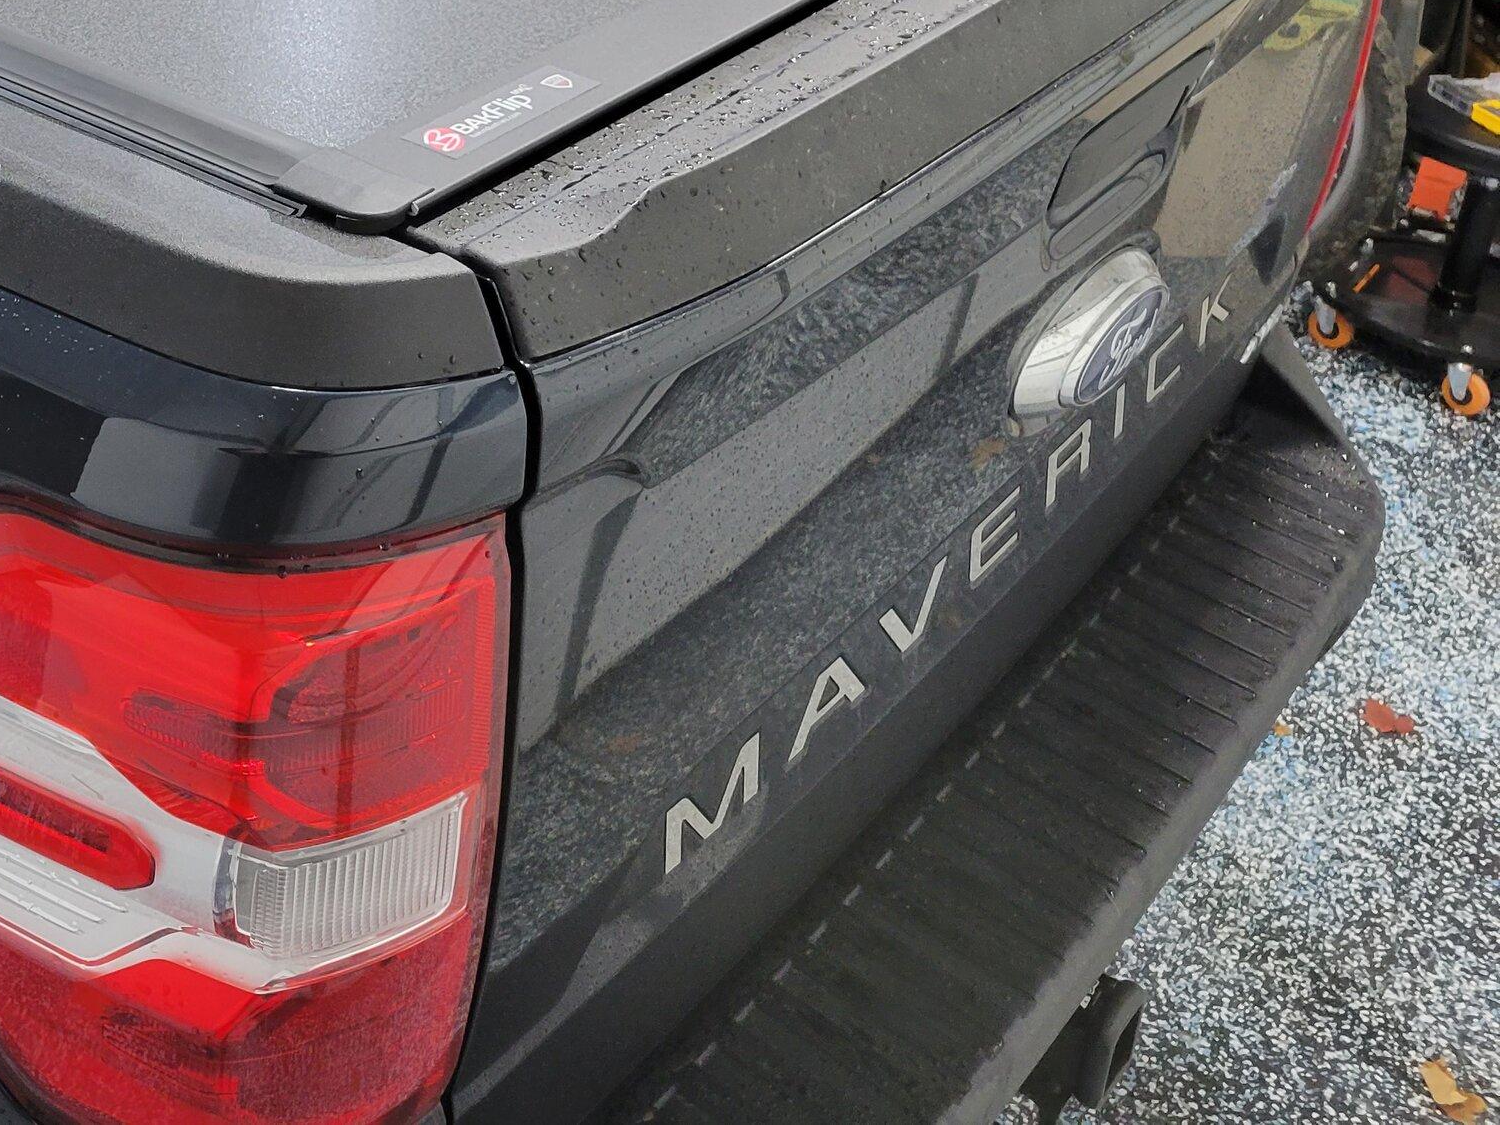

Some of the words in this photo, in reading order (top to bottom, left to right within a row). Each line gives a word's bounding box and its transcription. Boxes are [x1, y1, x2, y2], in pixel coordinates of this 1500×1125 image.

[449, 94, 533, 135] BAKFlip
[1098, 307, 1159, 390] Ford
[663, 272, 1231, 875] MAVERICK
